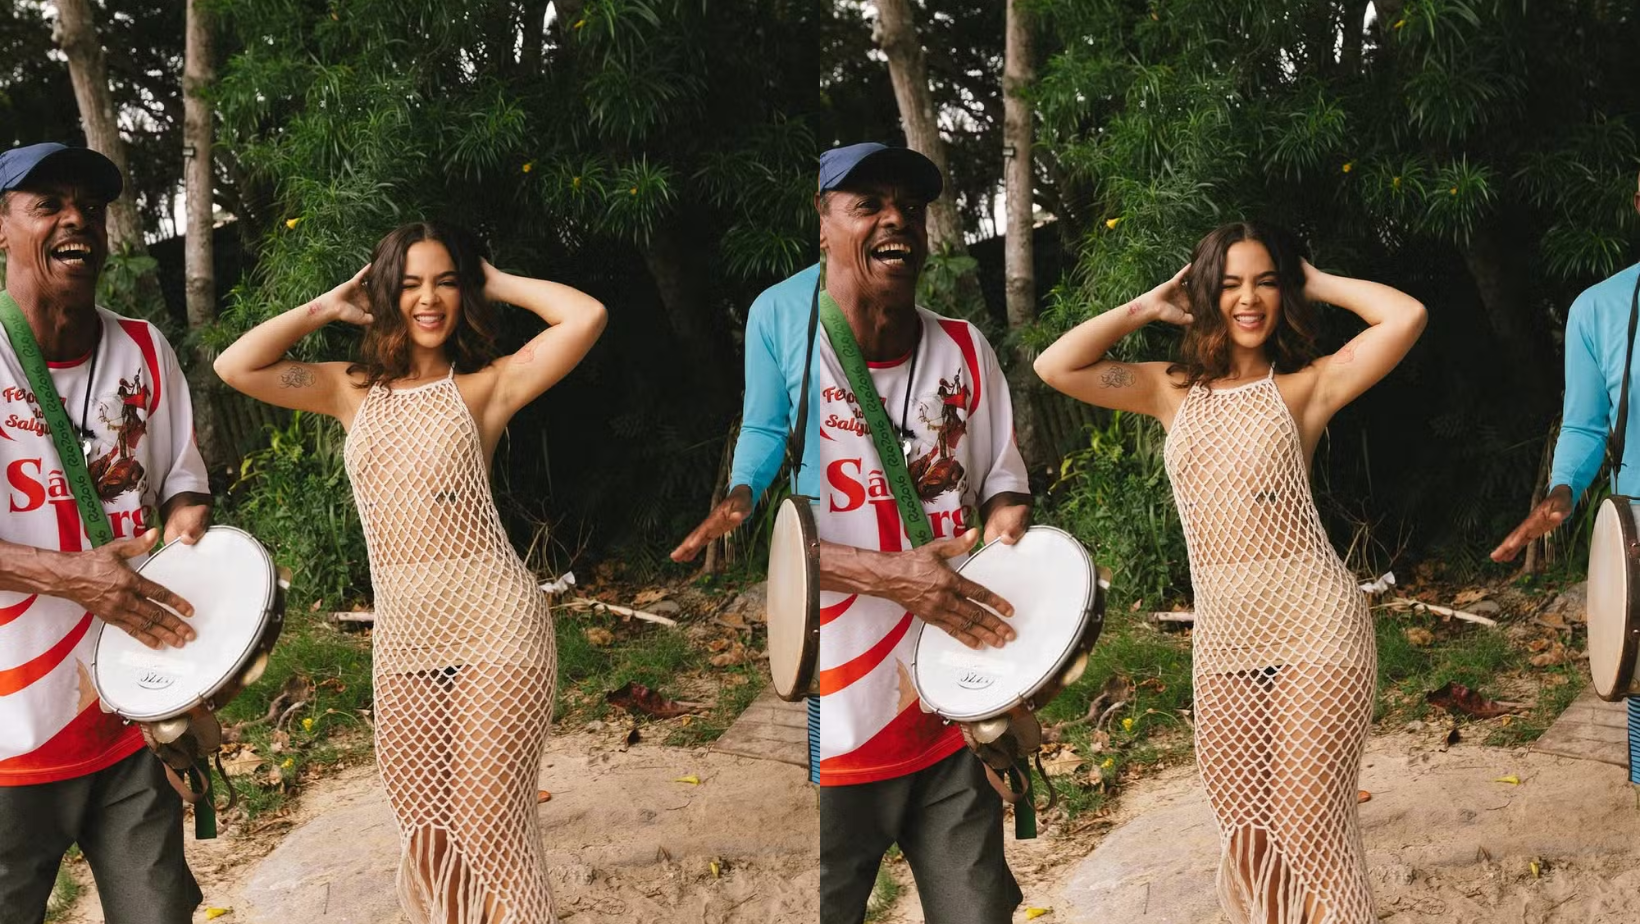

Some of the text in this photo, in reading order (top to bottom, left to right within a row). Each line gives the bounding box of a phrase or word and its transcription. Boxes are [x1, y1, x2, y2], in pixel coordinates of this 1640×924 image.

[31, 366, 58, 413] Rio2016
[851, 366, 878, 413] Rio2016
[55, 419, 79, 467] Rio2016
[875, 419, 899, 467] Rio2016
[6, 457, 74, 513] Sã
[75, 475, 99, 523] Rio2016
[826, 457, 894, 513] Sã
[895, 475, 919, 523] Rio2016
